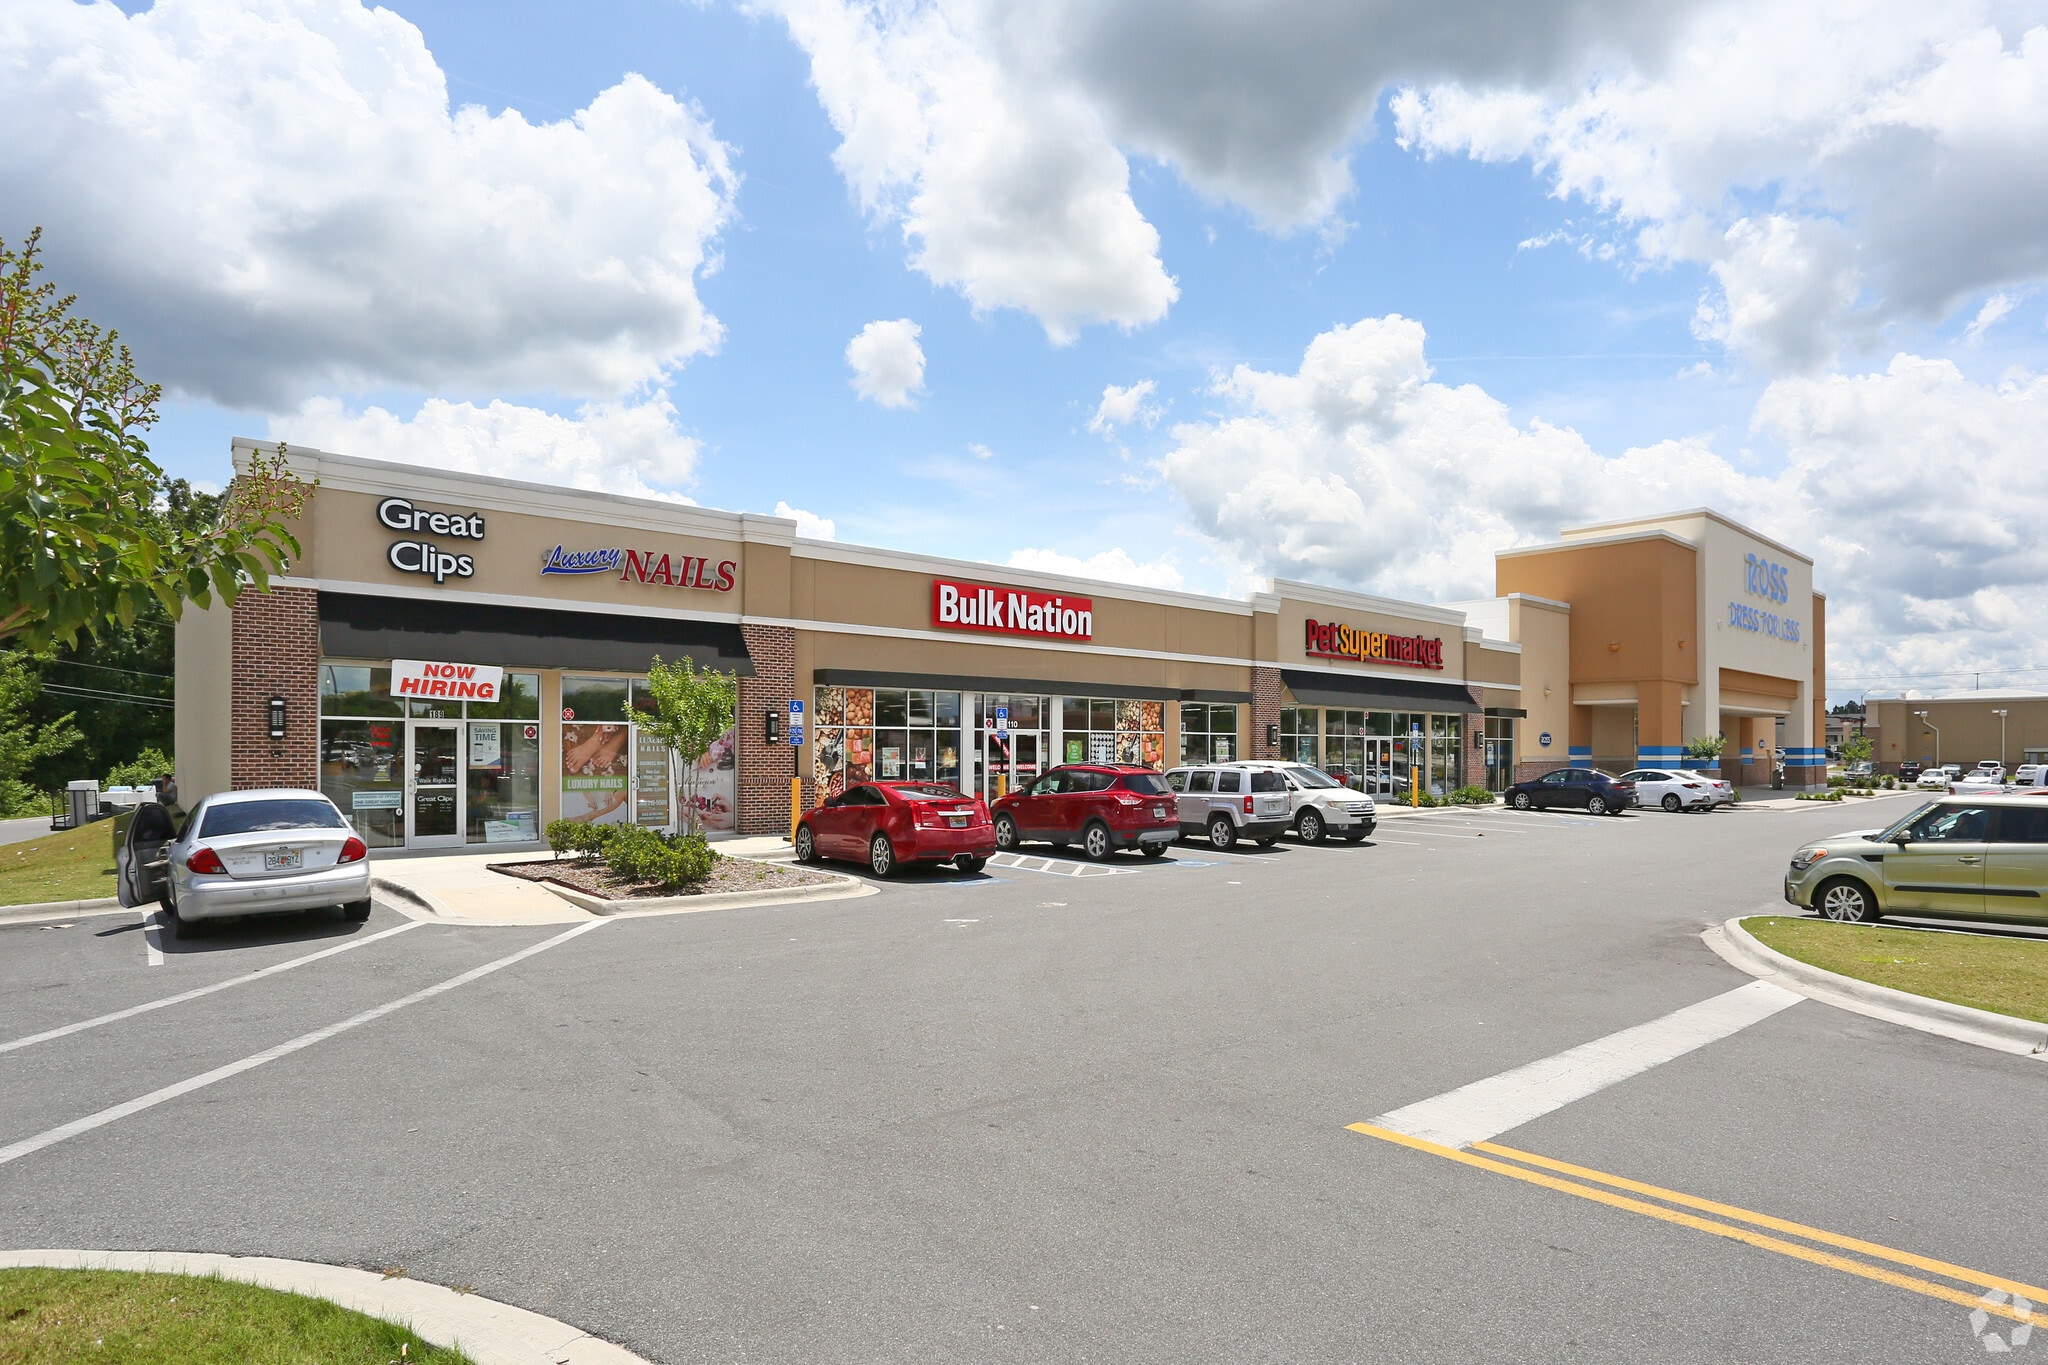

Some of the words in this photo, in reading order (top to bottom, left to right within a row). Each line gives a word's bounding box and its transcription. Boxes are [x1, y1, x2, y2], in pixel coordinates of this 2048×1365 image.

[378, 498, 485, 540] Great
[388, 541, 475, 583] Clips
[541, 544, 622, 574] Luxury
[619, 549, 736, 592] NAILS
[1744, 552, 1788, 604] ROSS
[939, 584, 1004, 628] Bulk
[1007, 592, 1092, 636] Nation
[1728, 601, 1759, 632] DRESS
[1760, 611, 1779, 637] FOR
[1779, 617, 1800, 642] LESS
[423, 663, 475, 680] NOW
[399, 677, 494, 699] HIRING
[430, 711, 444, 719] 189
[1007, 720, 1018, 728] 110
[474, 733, 497, 741] TIME
[567, 778, 598, 789] LUXURY
[600, 778, 623, 788] NAILS
